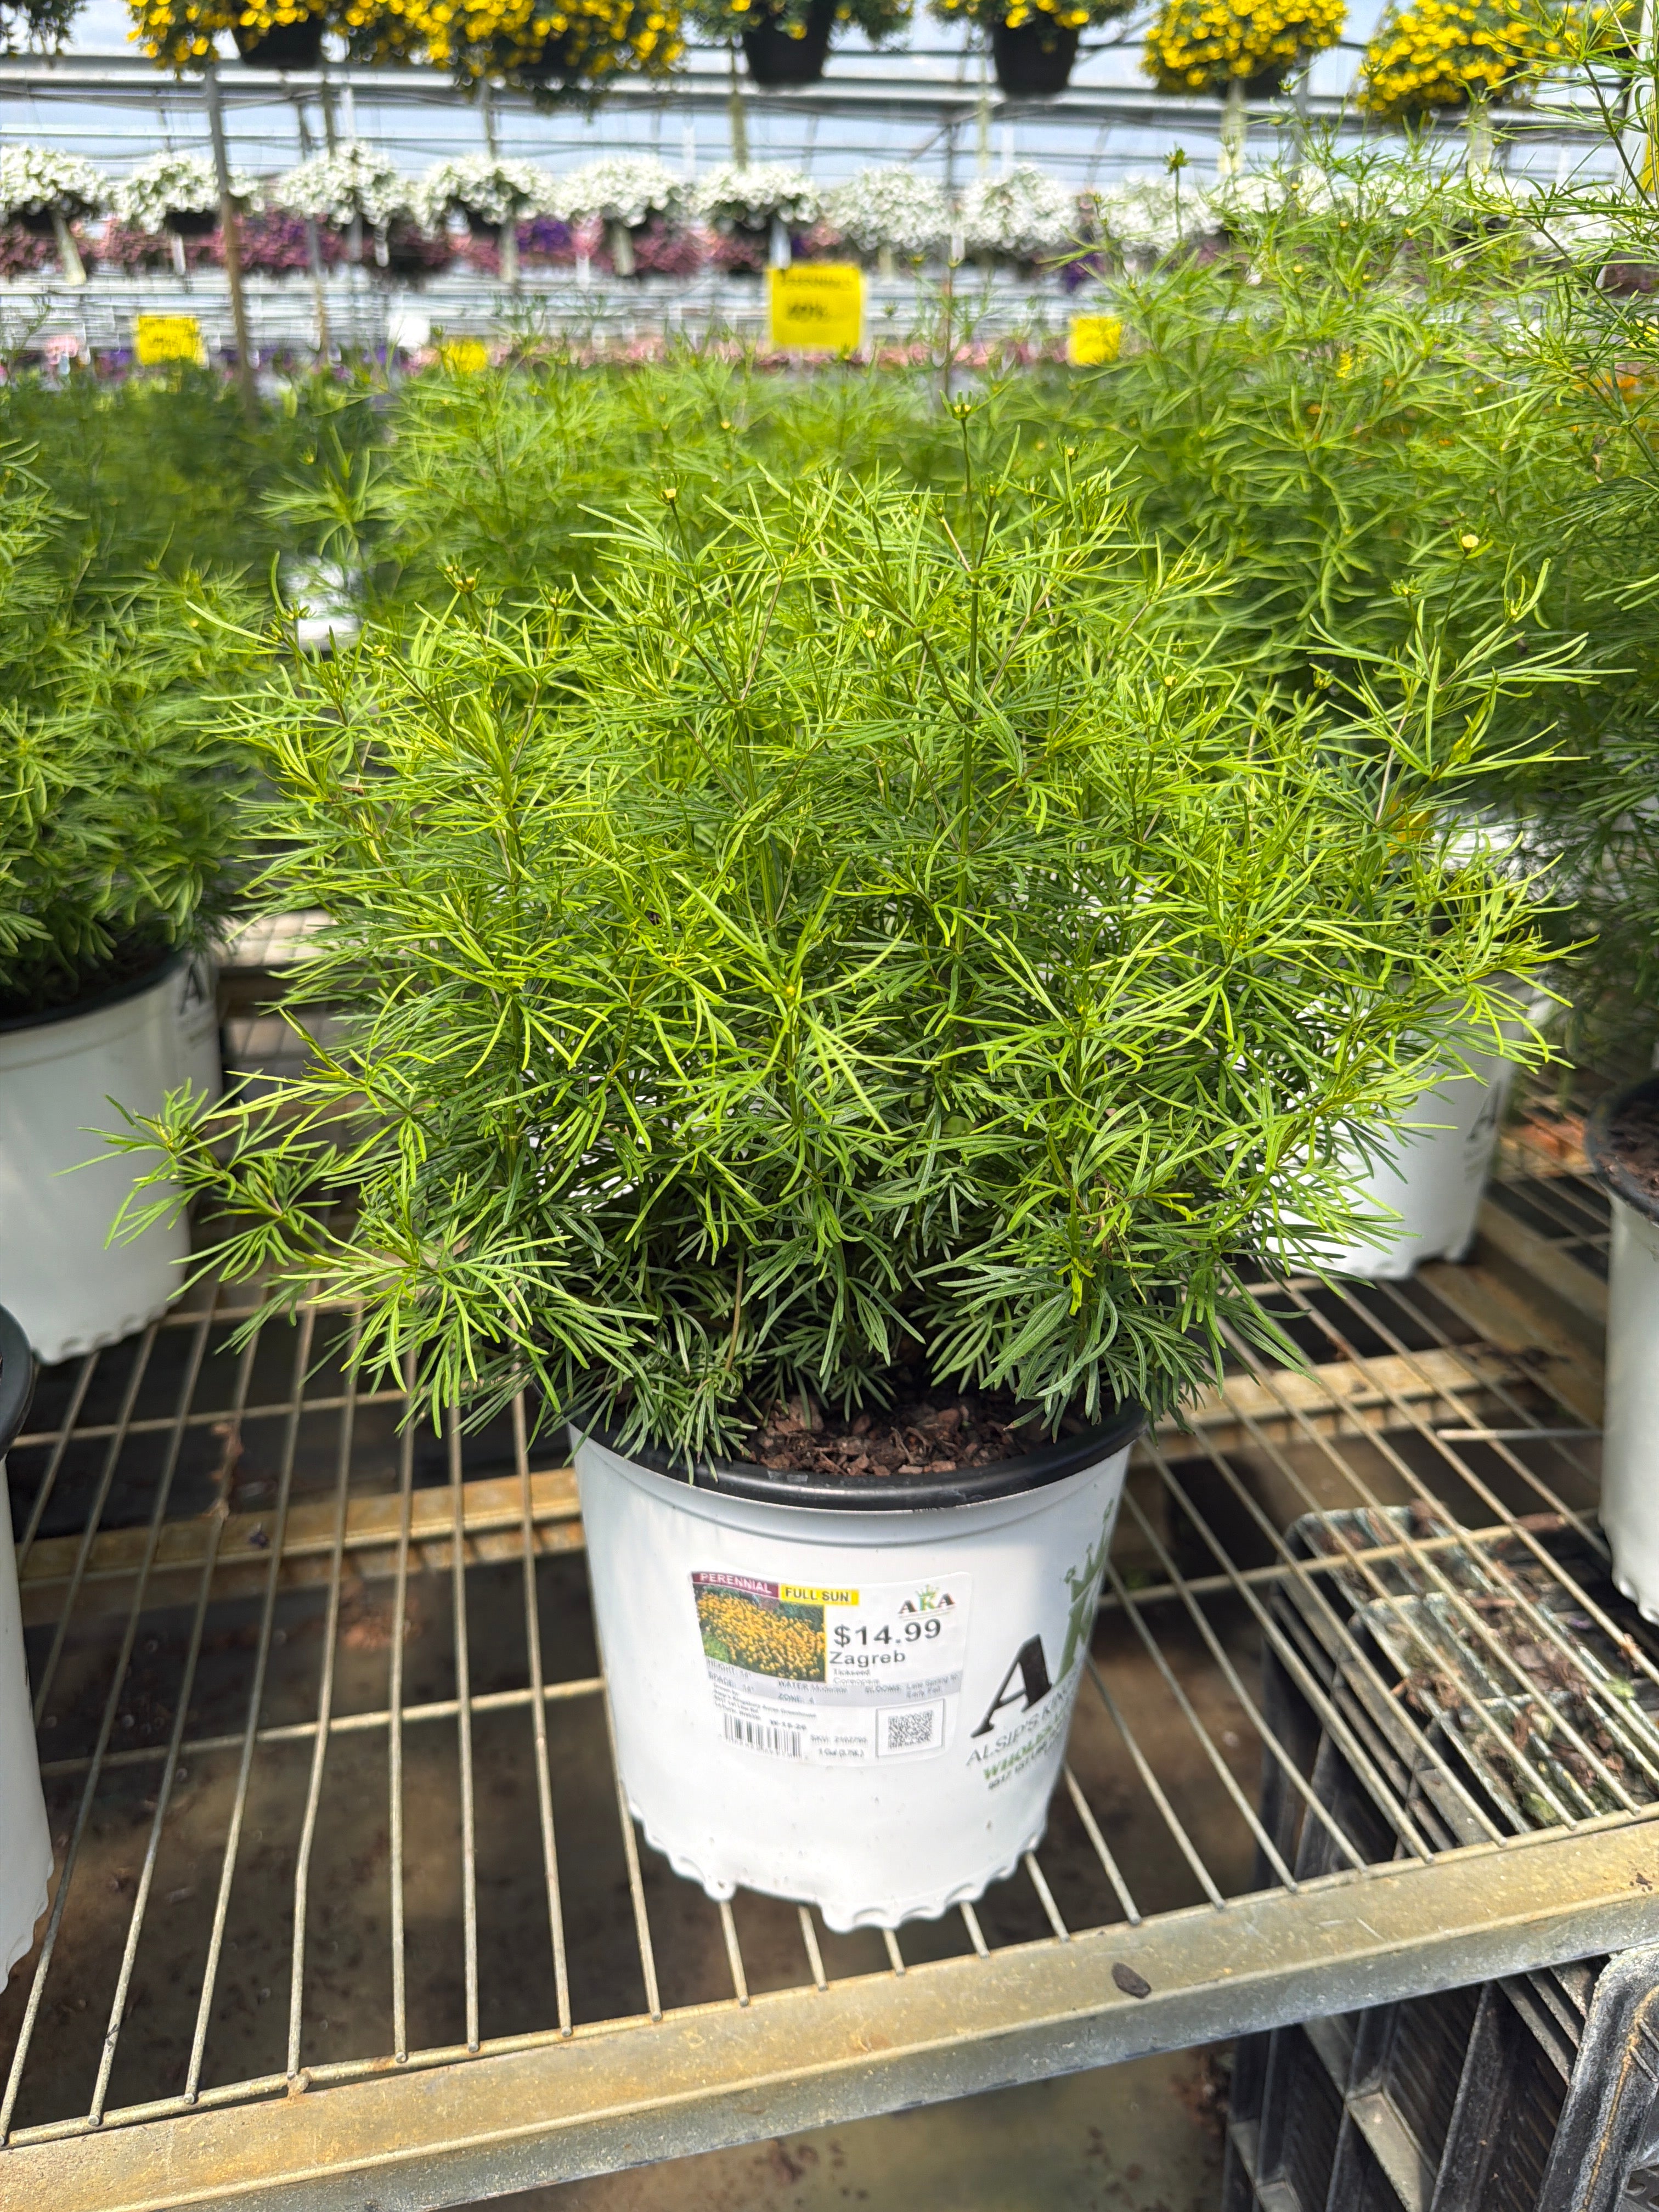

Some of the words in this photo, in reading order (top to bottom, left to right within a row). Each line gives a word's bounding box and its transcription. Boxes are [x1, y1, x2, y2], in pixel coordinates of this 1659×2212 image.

[699, 1572, 772, 1594] PERENNIAL
[785, 1587, 818, 1600] FULL
[821, 1591, 850, 1602] SUN
[898, 1592, 956, 1614] AKA
[833, 1618, 942, 1648] $14.99
[829, 1649, 906, 1668] Zagreb
[833, 1668, 871, 1677] Tickseed
[833, 1677, 881, 1685] Coreopsis
